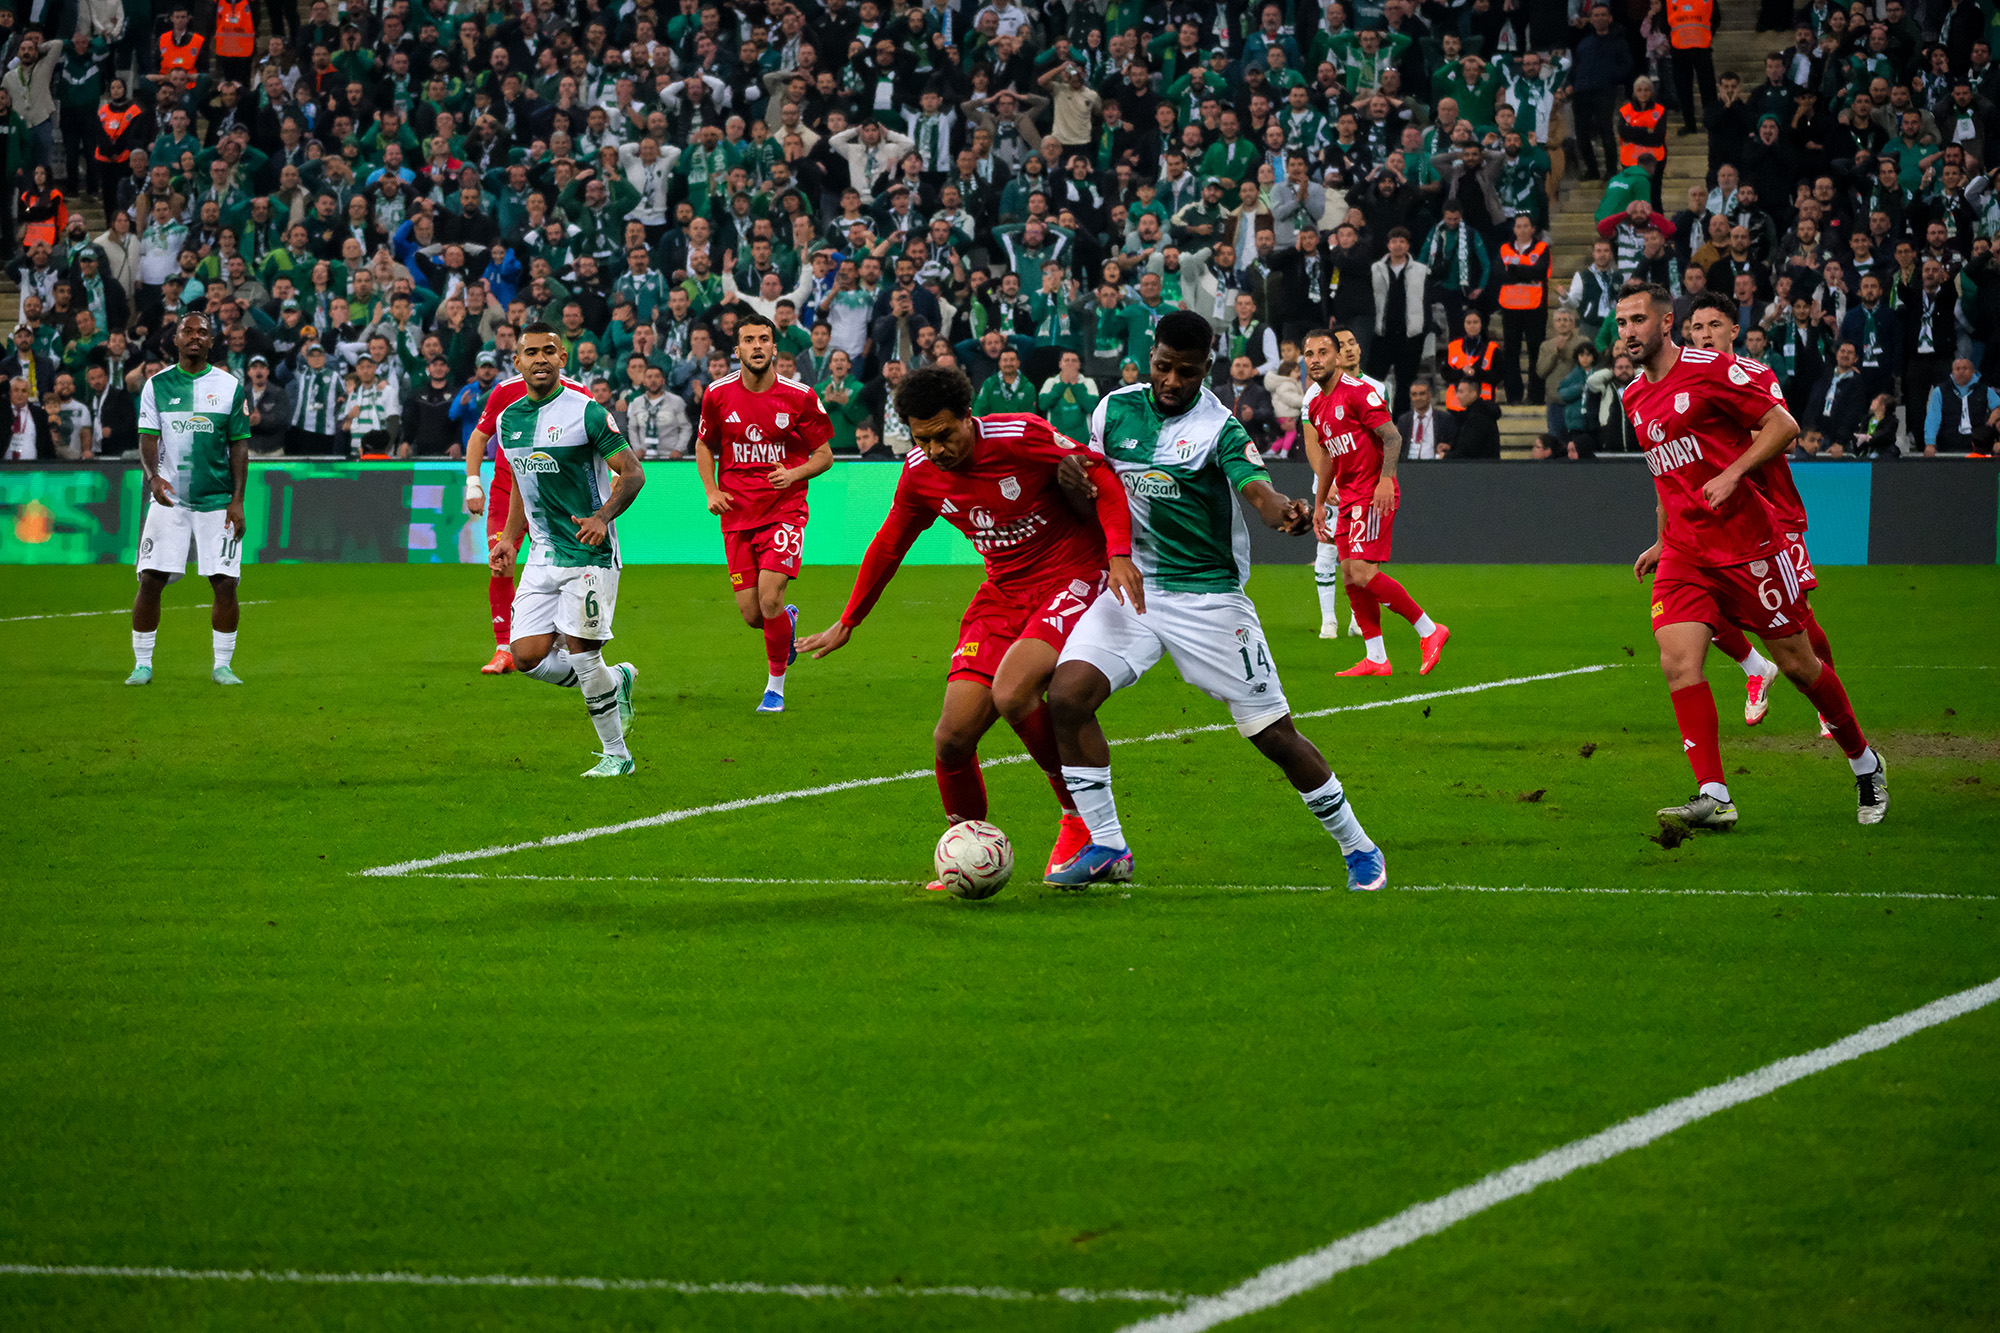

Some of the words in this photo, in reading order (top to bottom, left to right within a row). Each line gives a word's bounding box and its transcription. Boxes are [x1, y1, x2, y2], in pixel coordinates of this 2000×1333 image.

[179, 419, 213, 433] Yörsan
[732, 441, 786, 463] RFAYAPI
[519, 457, 559, 475] Yörsan
[1131, 473, 1179, 496] Yörsan
[220, 537, 237, 559] 10
[773, 530, 800, 556] 93
[1790, 543, 1810, 571] 2
[585, 590, 599, 618] 6
[1047, 590, 1087, 617] 17
[1757, 578, 1782, 611] 6
[1239, 642, 1271, 681] 14
